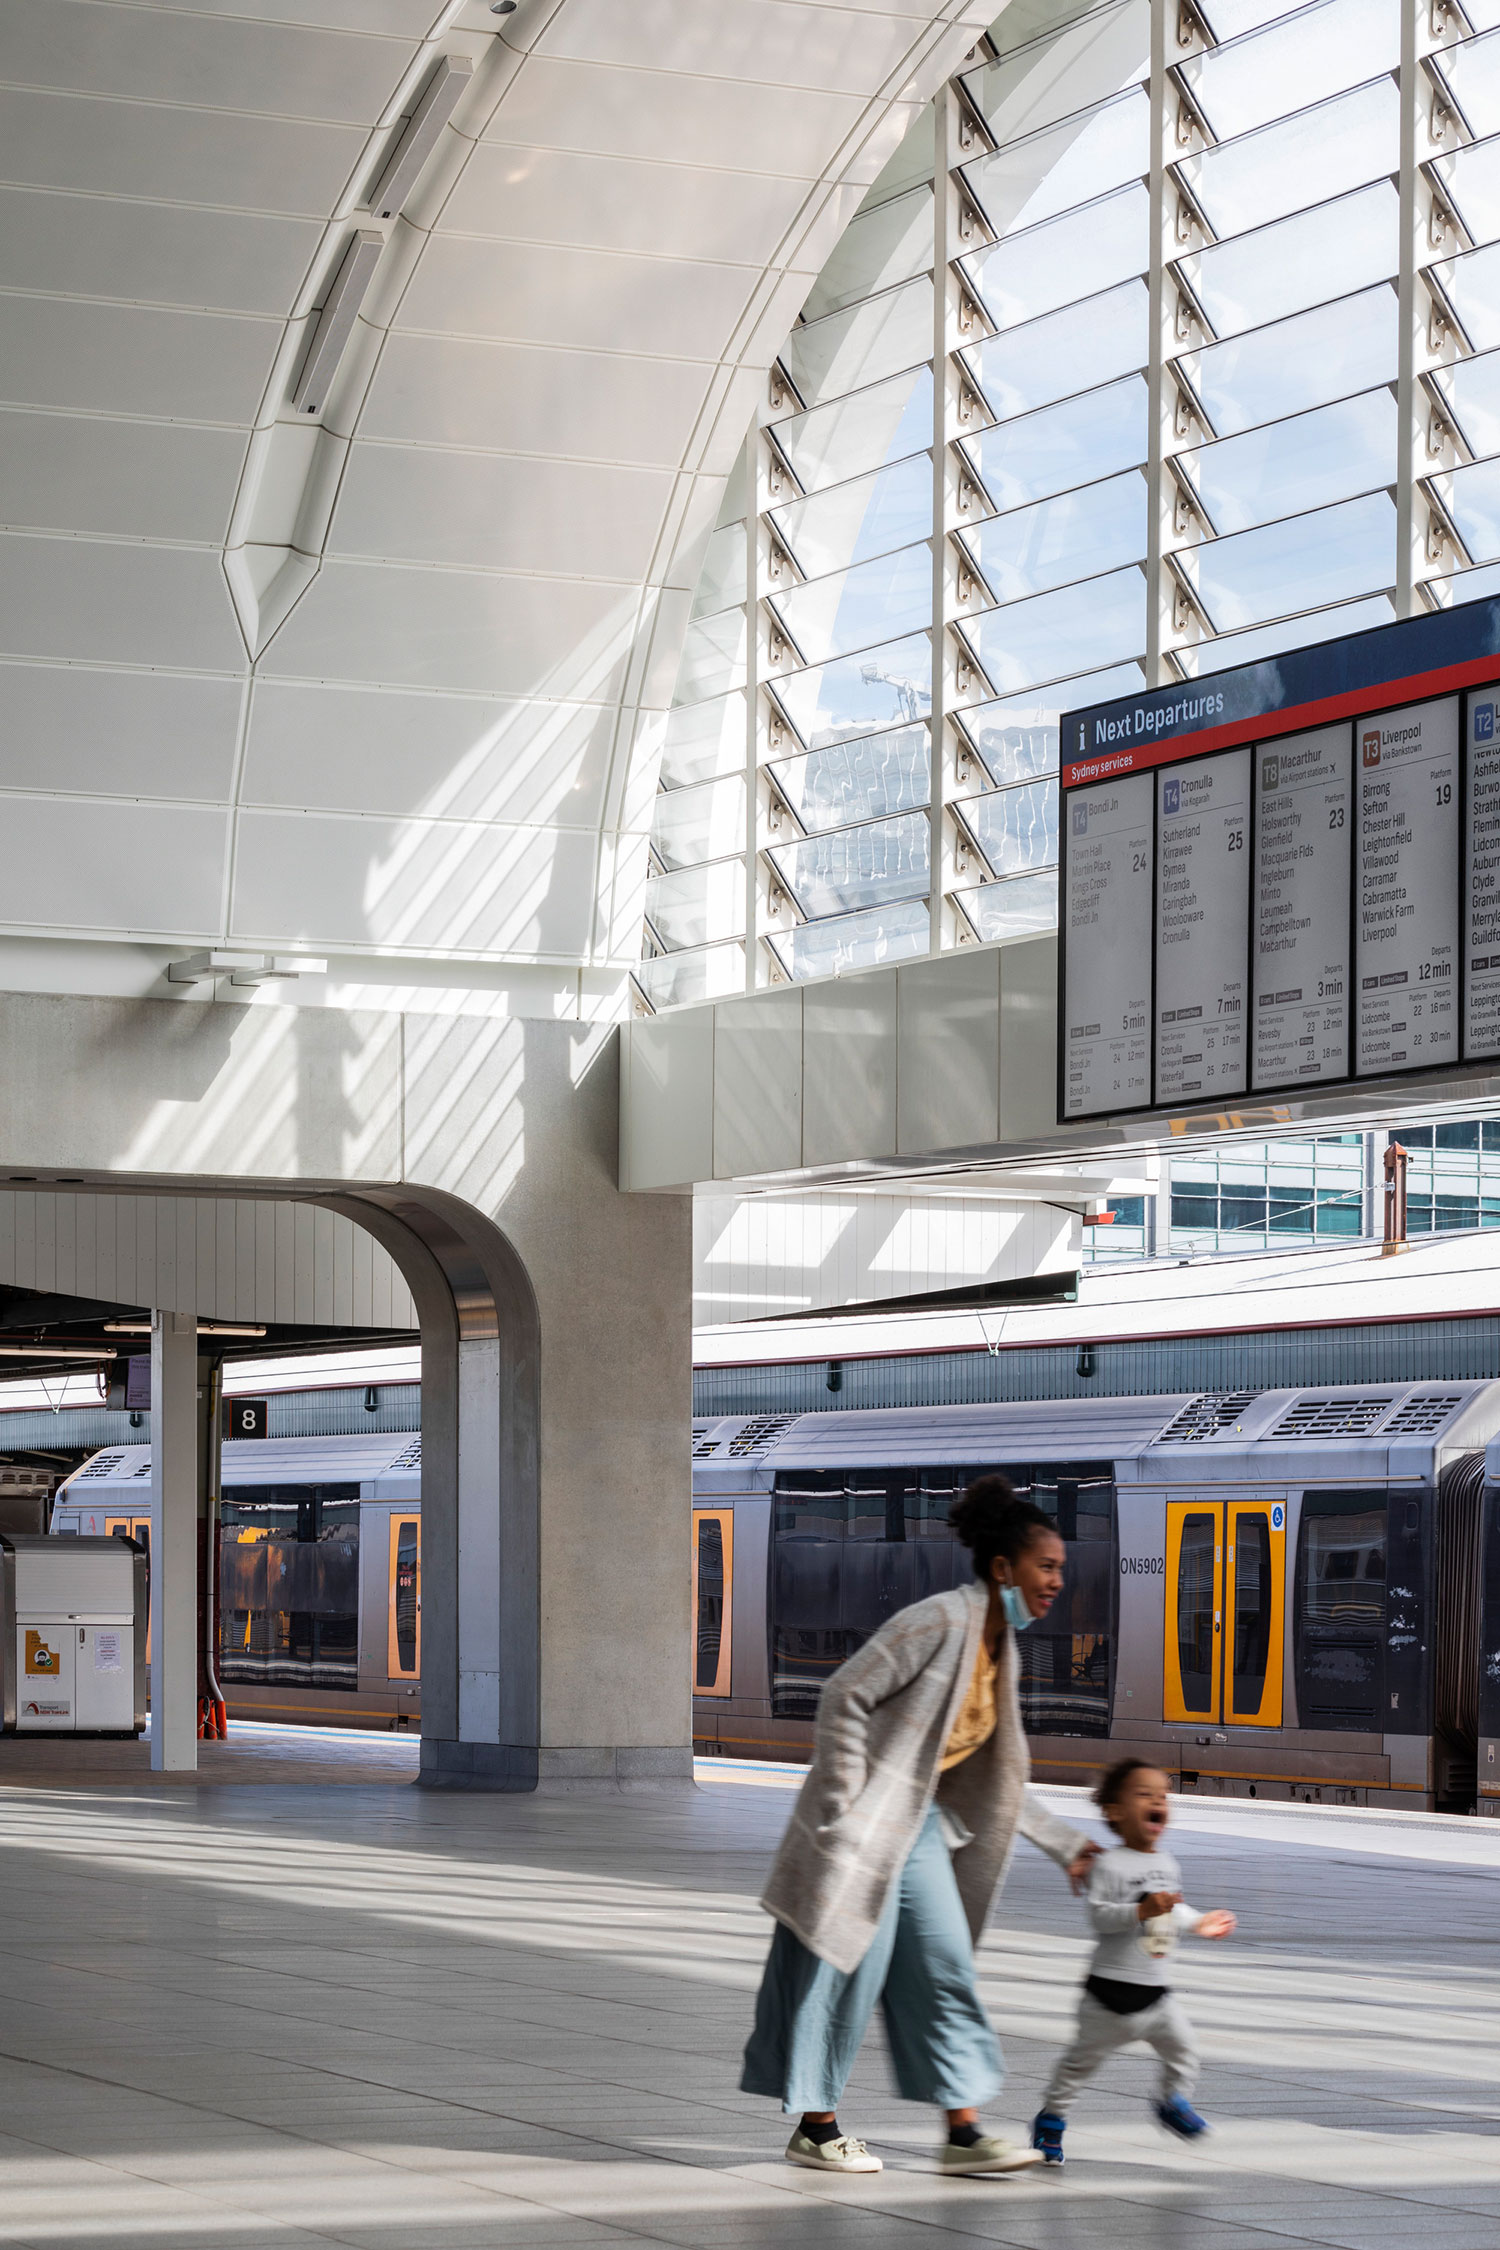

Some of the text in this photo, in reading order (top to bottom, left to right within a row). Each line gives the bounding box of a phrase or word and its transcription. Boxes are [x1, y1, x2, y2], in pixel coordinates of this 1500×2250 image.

[1096, 693, 1224, 744] Next Departures
[1476, 712, 1491, 732] T2
[1382, 722, 1421, 745] Liverpool
[1365, 740, 1378, 759] T3
[1382, 743, 1422, 760] via Bankstown
[1280, 749, 1322, 770] Macarthur
[1072, 754, 1133, 782] Sydney services
[1263, 764, 1277, 784] T8
[1280, 765, 1328, 784] via Airport stations
[1430, 769, 1452, 780] Platform
[1181, 774, 1213, 794] Cronulla
[1363, 782, 1390, 798] Birrong
[1165, 788, 1177, 806] T4
[1324, 793, 1345, 804] Platform
[1436, 784, 1452, 806] 19
[1089, 798, 1119, 816] Bondi Jn
[1262, 796, 1293, 814] East Hills
[1363, 801, 1388, 817] Sefton
[1074, 810, 1086, 828] T4
[1224, 816, 1243, 826] Platform
[1261, 812, 1302, 832] Holsworthy
[1329, 808, 1345, 829] 23
[1363, 812, 1405, 834] Chester Hill
[1163, 823, 1200, 844] Sutherland
[1228, 831, 1243, 851] 25
[1261, 832, 1293, 849] Glenfield
[1363, 829, 1412, 854] Leightonfield
[1072, 844, 1102, 861] Town Hall
[1163, 844, 1192, 860] Kirrawee
[1261, 844, 1314, 867] Macquarie Flds
[1363, 850, 1399, 870] Villawood
[1094, 860, 1111, 873] Place
[1133, 852, 1147, 872] 24
[1163, 862, 1186, 879] Gymea
[1261, 867, 1294, 886] Ingleburn
[1090, 877, 1107, 891] Cross
[1163, 878, 1190, 894] Miranda
[1363, 871, 1397, 888] Carramar
[1473, 874, 1495, 891] Clyde
[1163, 892, 1197, 911] Caringbah
[1261, 887, 1281, 902] Minto
[1362, 886, 1407, 907] Cabramatta
[1260, 901, 1293, 919] Leumeah
[1362, 903, 1414, 925] Warwick Farm
[1162, 909, 1204, 928] Woolooware
[1260, 916, 1311, 937] Campbelltown
[1162, 928, 1190, 944] Cronulla
[1362, 923, 1397, 943] Liverpool
[1260, 937, 1297, 953] Macarthur
[1432, 945, 1451, 956] Departs
[1325, 964, 1342, 975] Departs
[1419, 960, 1451, 980] 12 min
[1224, 982, 1241, 992] Departs
[1318, 981, 1324, 997] 3
[1325, 979, 1342, 996] min
[1434, 989, 1451, 998] Departs
[1471, 981, 1500, 992] Next Services
[1217, 999, 1223, 1014] 7
[1224, 996, 1240, 1013] min
[1362, 1000, 1389, 1010] Next Services
[1409, 993, 1427, 1002] Platform
[1413, 1005, 1422, 1016] 22
[1431, 1001, 1451, 1013] 16 min
[1478, 1010, 1496, 1020] Granville
[1122, 1016, 1129, 1030] 5
[1130, 1013, 1145, 1029] min
[1323, 1018, 1342, 1030] 12 min
[1362, 1011, 1390, 1025] Lidcombe
[1258, 1028, 1281, 1040] Revesby
[1307, 1022, 1315, 1033] 23
[1369, 1027, 1391, 1036] Bankstown
[1207, 1038, 1215, 1049] 25
[1222, 1034, 1240, 1046] 17 min
[1413, 1034, 1422, 1046] 22
[1430, 1030, 1451, 1043] 30 min
[1161, 1043, 1182, 1056] Cronulla
[1323, 1046, 1342, 1058] 18 min
[1362, 1040, 1390, 1053] Lidcombe
[1113, 1053, 1120, 1063] 24
[1128, 1050, 1145, 1061] 12 min
[1258, 1055, 1287, 1068] Macarthur
[1307, 1050, 1315, 1061] 23
[1369, 1056, 1391, 1065] Bankstown
[1207, 1065, 1214, 1076] 25
[1221, 1061, 1240, 1074] 27 min
[1128, 1076, 1144, 1088] 17 min
[1161, 1070, 1184, 1083] Waterfall
[1113, 1080, 1120, 1090] 24
[242, 1409, 256, 1430] 8
[1121, 1557, 1163, 1574] ON5902
